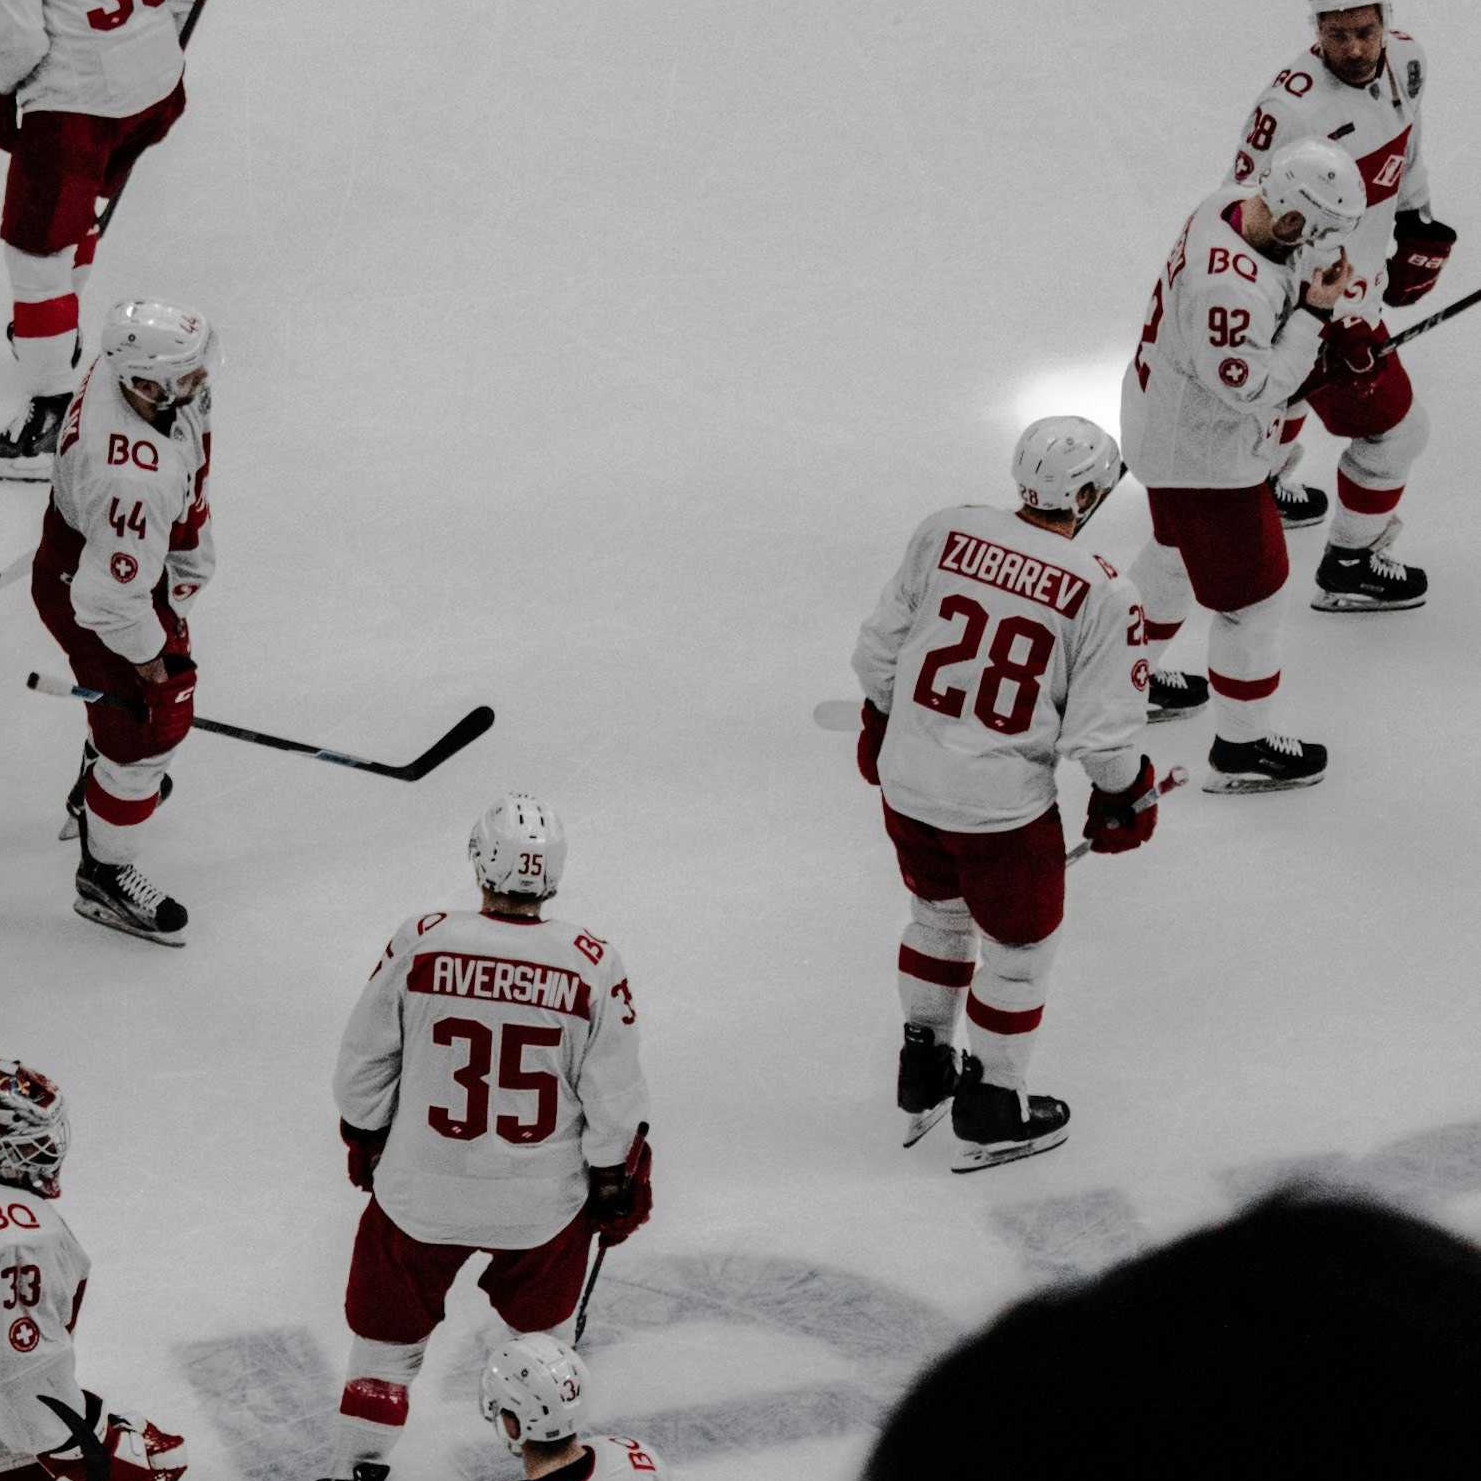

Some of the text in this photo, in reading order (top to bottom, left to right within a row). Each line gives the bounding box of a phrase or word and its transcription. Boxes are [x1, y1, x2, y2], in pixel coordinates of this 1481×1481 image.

[1207, 247, 1258, 284] BQ
[1208, 306, 1251, 348] 92
[107, 433, 159, 472] BQ
[1019, 483, 1039, 506] 28
[108, 497, 147, 541] 44
[941, 532, 1084, 613] ZUBAREV
[913, 593, 1089, 737] 28
[518, 852, 544, 877] 35
[432, 955, 581, 1013] AVERSHIN
[427, 1016, 563, 1145] 35
[0, 1263, 42, 1310] 33
